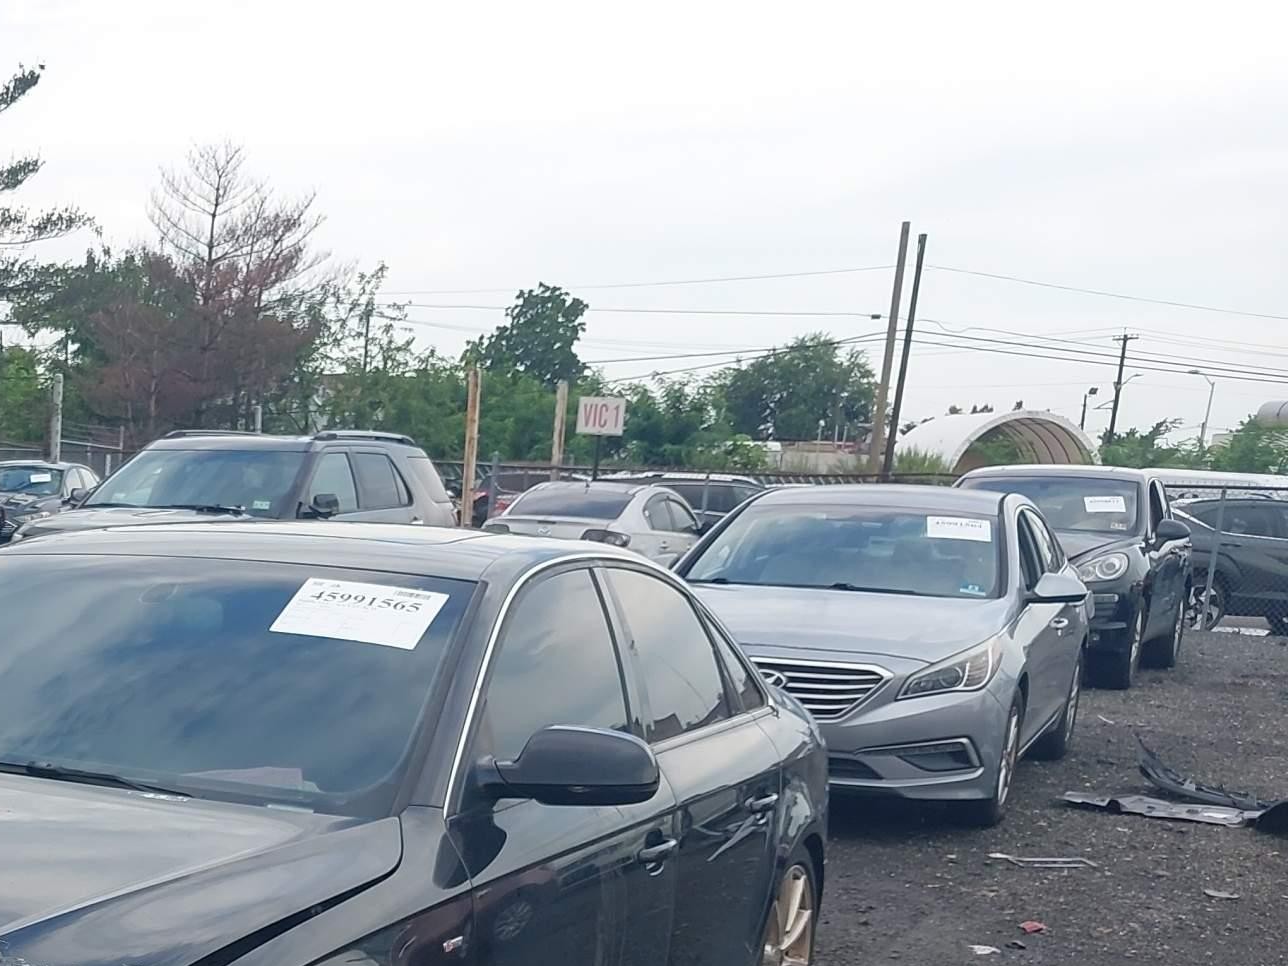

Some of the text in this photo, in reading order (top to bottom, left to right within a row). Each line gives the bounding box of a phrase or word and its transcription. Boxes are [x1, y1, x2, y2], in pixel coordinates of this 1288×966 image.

[583, 403, 620, 429] VIC 1
[310, 590, 423, 613] 45991565
